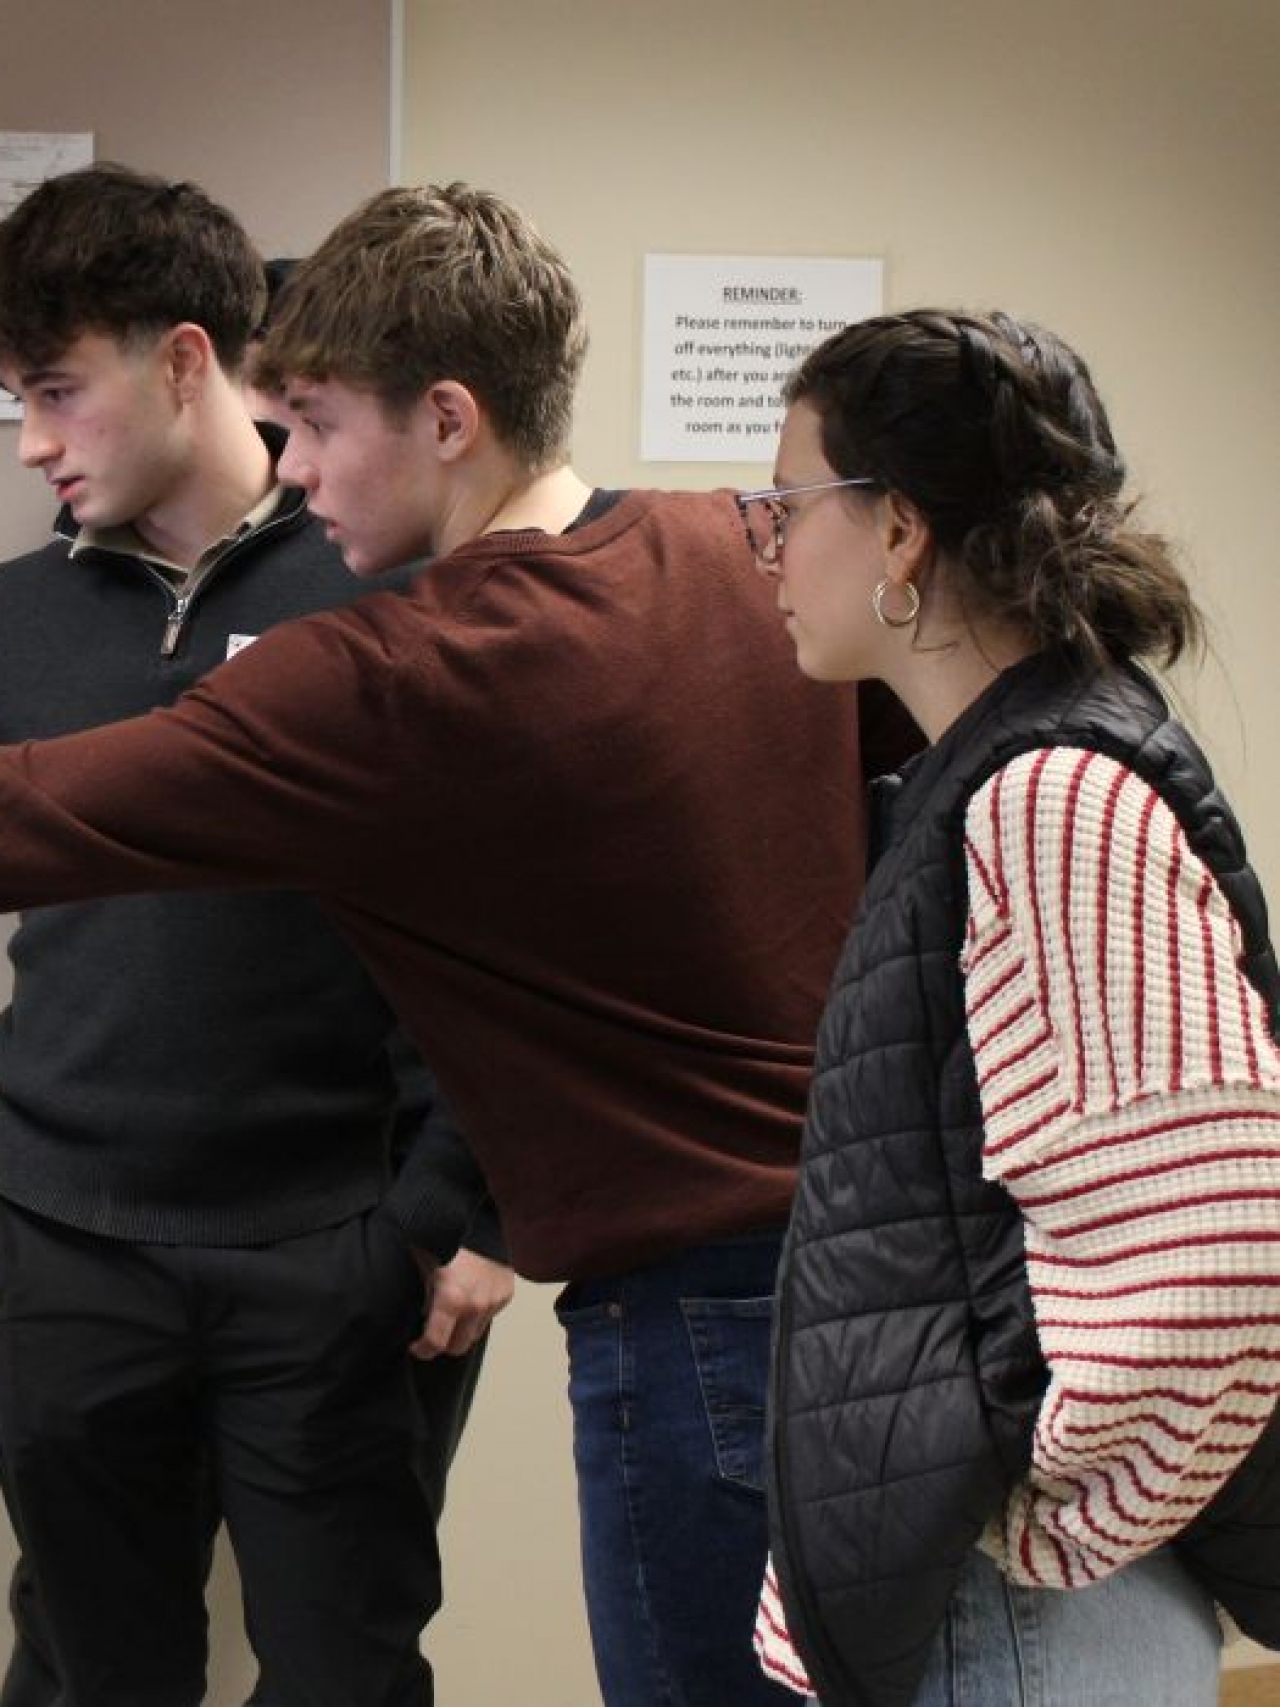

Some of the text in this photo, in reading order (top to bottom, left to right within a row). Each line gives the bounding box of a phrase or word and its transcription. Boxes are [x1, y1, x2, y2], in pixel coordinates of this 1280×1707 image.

[722, 286, 803, 304] REMINDER:
[675, 314, 846, 331] Please remember to turn
[674, 341, 694, 355] off
[696, 341, 770, 359] everything
[671, 367, 702, 384] etc.)
[706, 367, 738, 382] after
[743, 371, 768, 384] you
[670, 394, 692, 408] the
[697, 396, 734, 408] room
[738, 394, 763, 408] and
[685, 422, 722, 433] room
[726, 422, 741, 433] as
[745, 423, 770, 435] you
